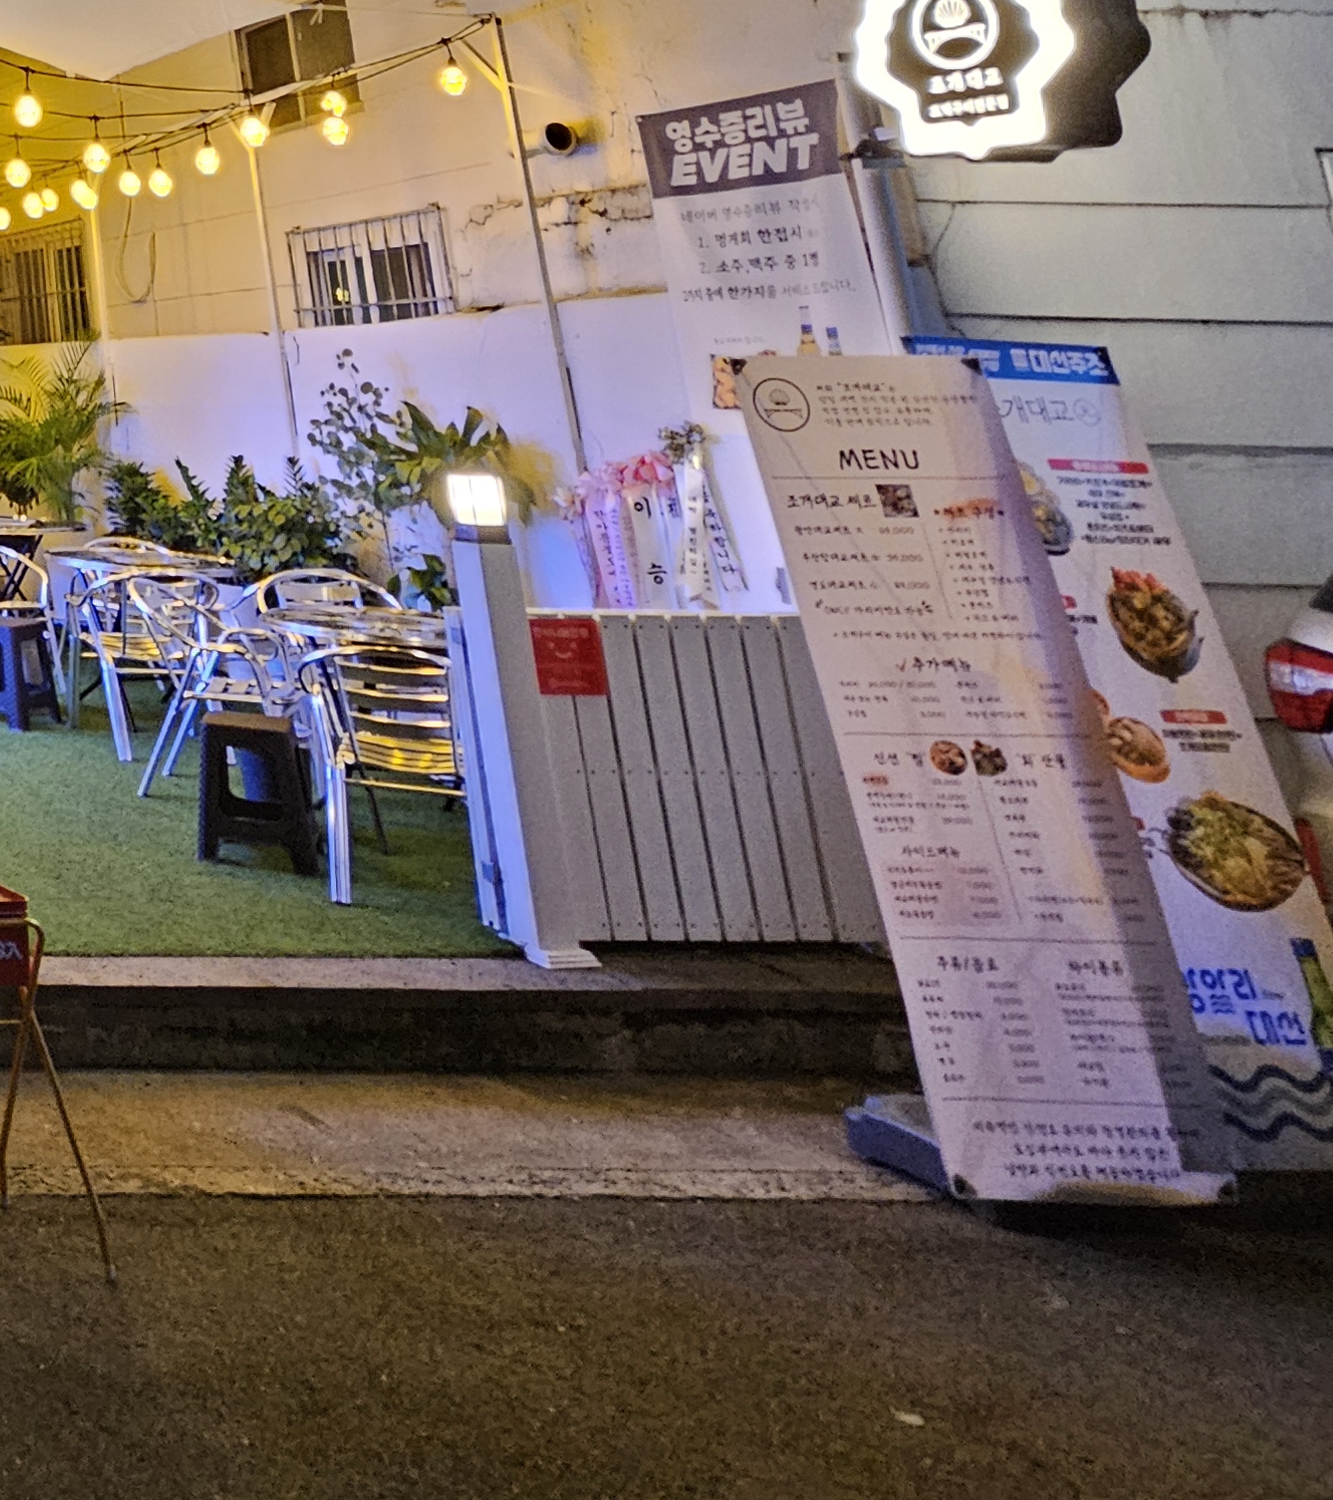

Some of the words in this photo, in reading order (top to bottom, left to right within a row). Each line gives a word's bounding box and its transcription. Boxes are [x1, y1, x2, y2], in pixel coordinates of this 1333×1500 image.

[665, 98, 810, 154] 영수증리뷰
[670, 132, 820, 187] EVENT
[838, 448, 920, 471] MENU
